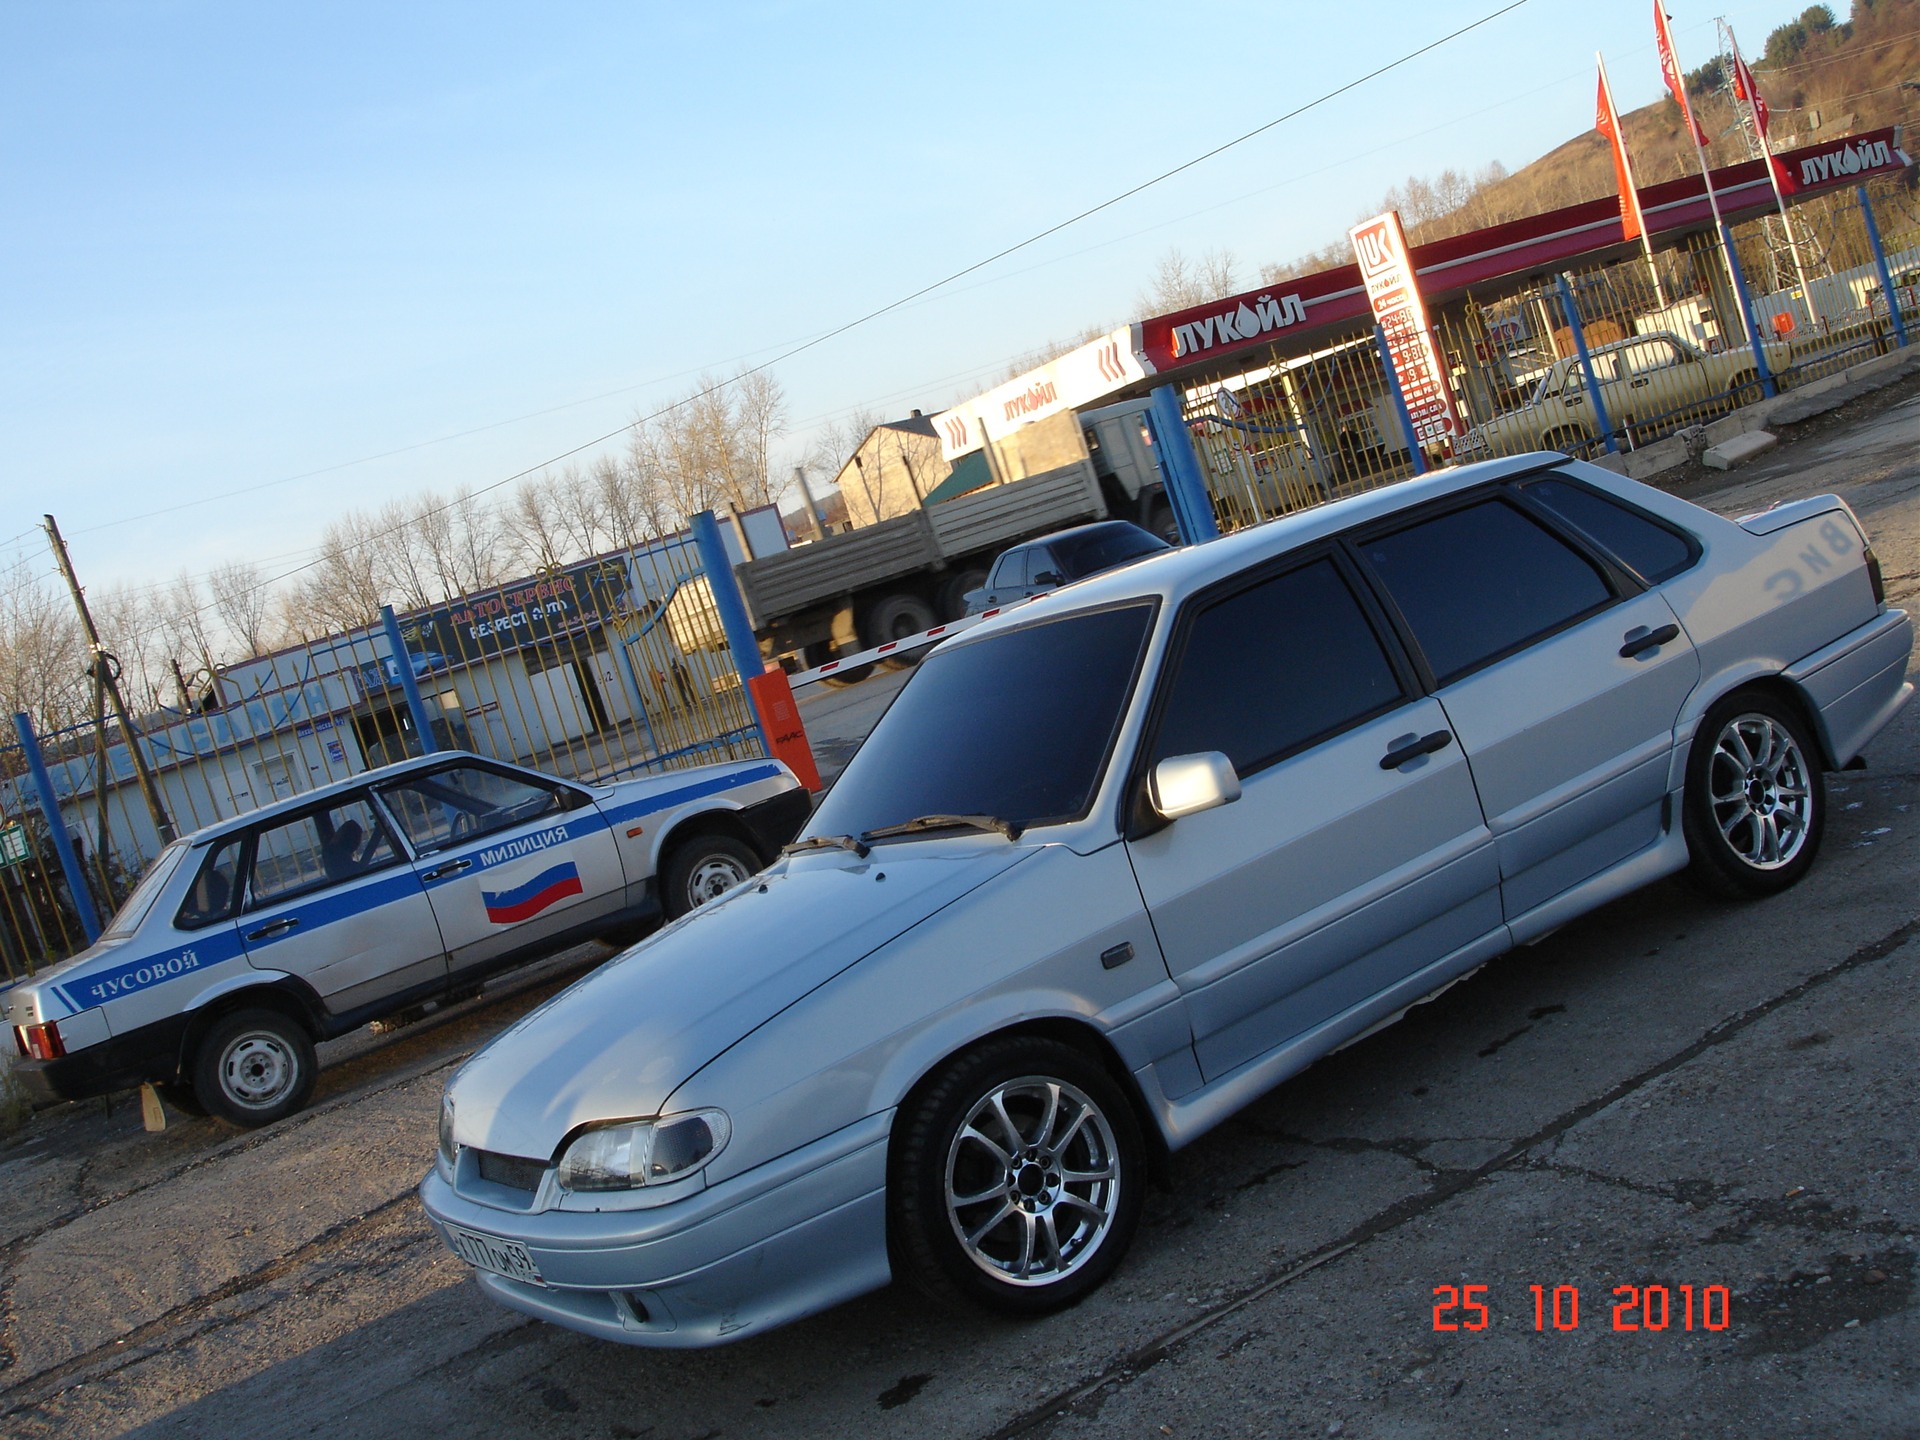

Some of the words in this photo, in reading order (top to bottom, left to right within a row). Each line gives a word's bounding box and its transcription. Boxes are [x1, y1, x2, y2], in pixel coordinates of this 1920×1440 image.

[1800, 139, 1893, 185] ЛУКОЙЛ
[1371, 273, 1401, 294] ЛУКОЙЛ
[1171, 293, 1307, 358] ЛУКОЙЛ
[1003, 381, 1058, 422] ЛУКОЙЛ
[450, 575, 577, 626] АВТОСЕРВИС
[480, 826, 569, 867] МИЛИЦИЯ
[90, 949, 200, 999] ЧУСОВОЙ
